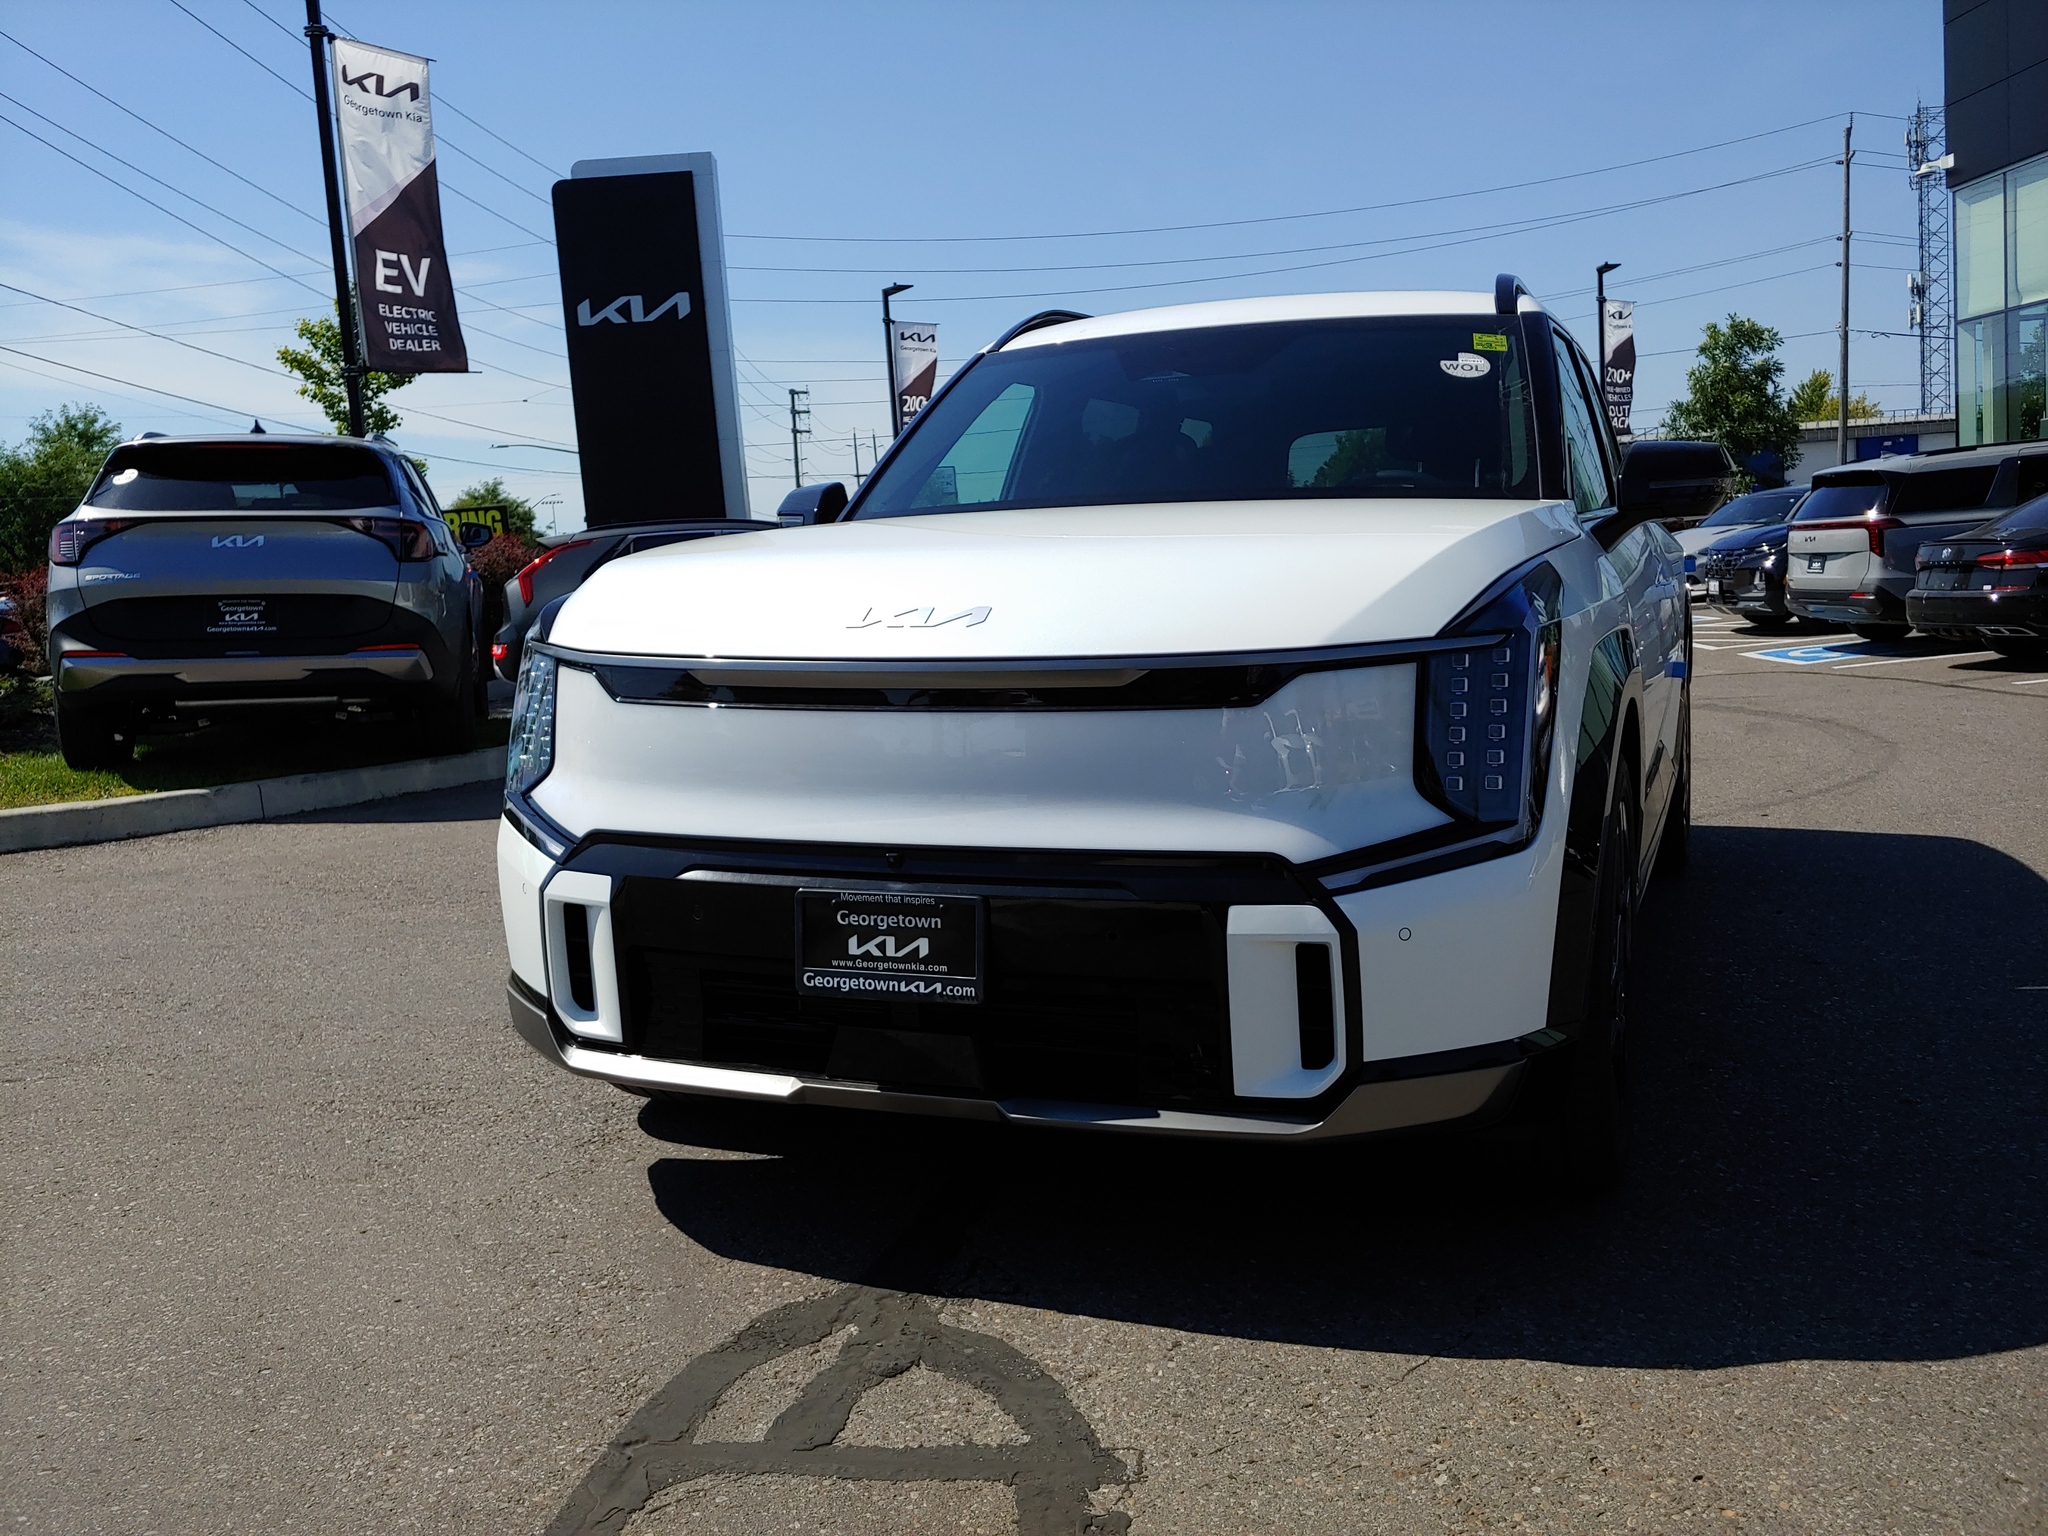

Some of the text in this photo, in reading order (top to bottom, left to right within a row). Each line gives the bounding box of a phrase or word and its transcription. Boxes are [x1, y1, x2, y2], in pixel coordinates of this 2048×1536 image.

[342, 64, 419, 102] KIA
[344, 95, 423, 123] Georgetown Kia
[375, 249, 431, 297] EV
[378, 303, 437, 322] ELECTRIC
[577, 291, 691, 326] KIA
[384, 321, 438, 336] VEHICLE
[900, 331, 935, 343] KIA
[389, 339, 441, 352] DEALER
[1444, 363, 1485, 372] WOL
[1609, 405, 1630, 417] OUT
[1611, 417, 1629, 429] AC
[212, 535, 264, 548] KIA
[225, 612, 258, 621] KIA
[846, 606, 992, 628] KIA
[840, 893, 935, 906] Movement that inspires
[836, 910, 942, 930] Georgetown
[848, 934, 929, 959] KIA
[831, 959, 948, 973] www.Georgetownkia.com
